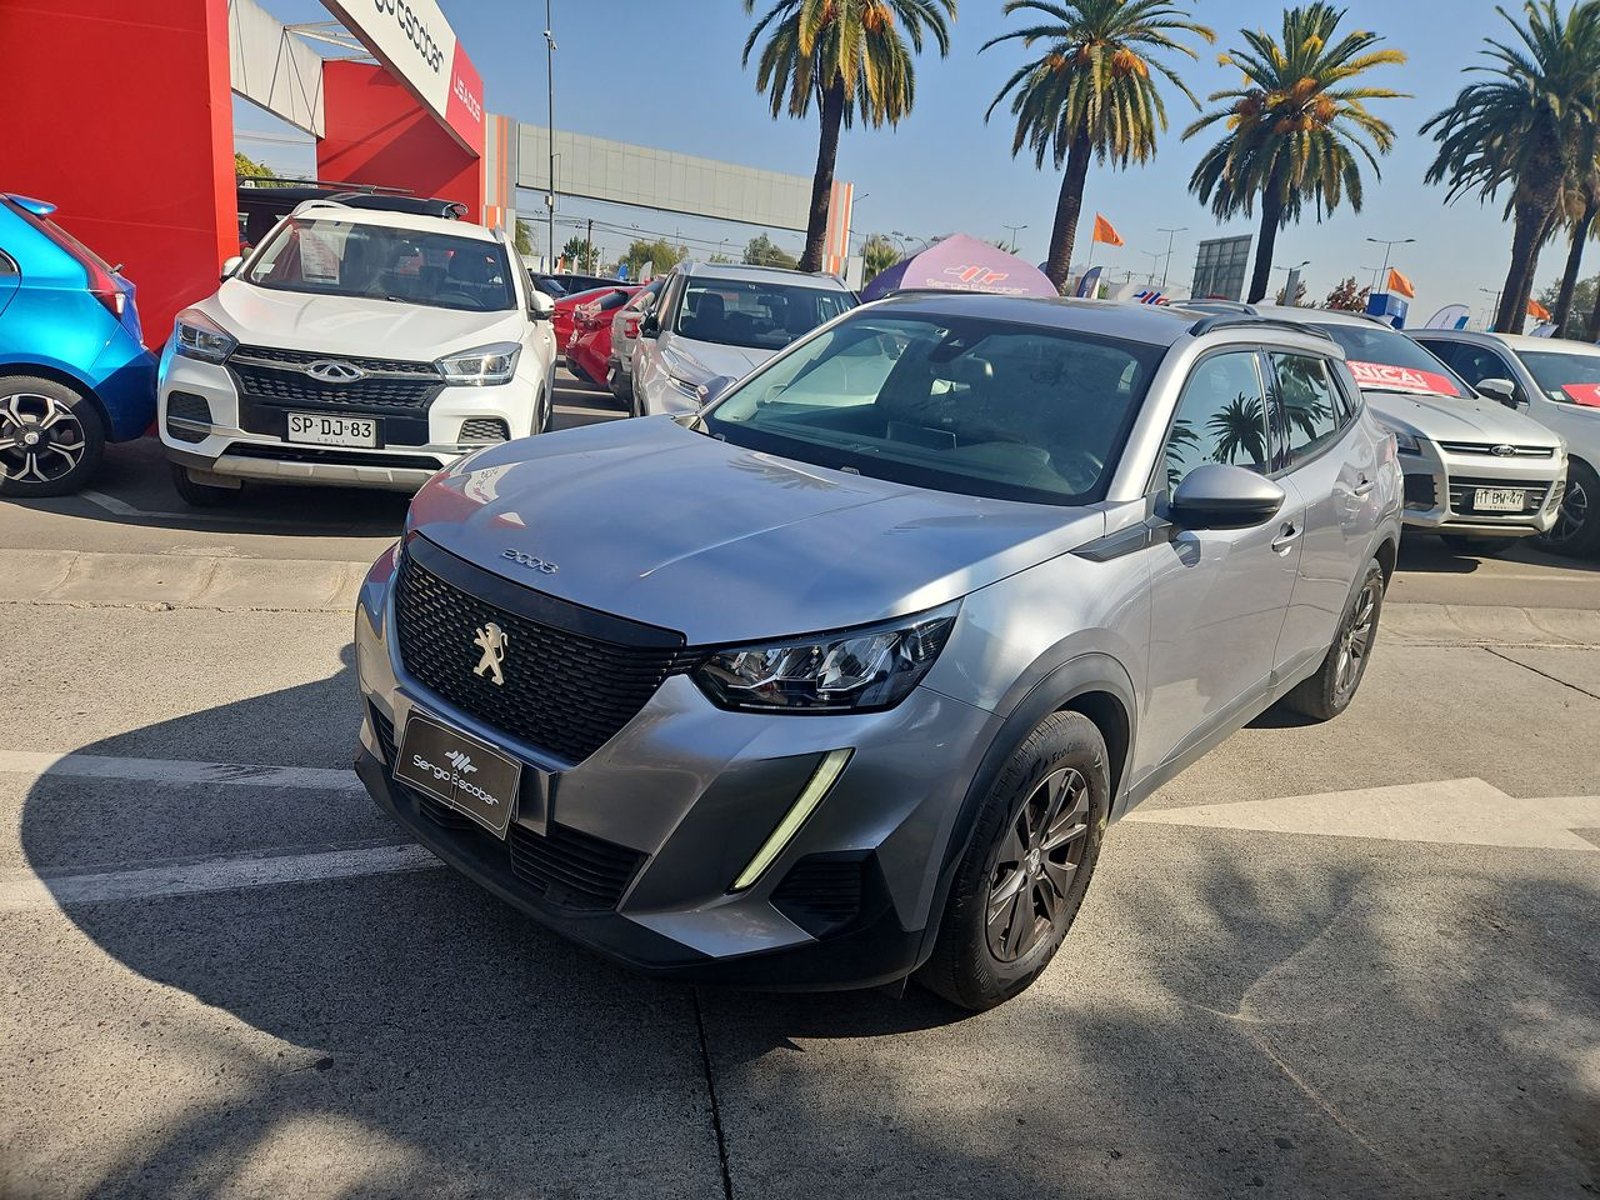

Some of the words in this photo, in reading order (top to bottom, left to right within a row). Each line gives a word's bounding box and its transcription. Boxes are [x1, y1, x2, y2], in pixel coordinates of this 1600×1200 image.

[453, 72, 480, 123] USADOS
[1350, 362, 1429, 388] NICA!
[502, 548, 559, 574] 2008
[412, 754, 451, 781] Sergo
[451, 772, 500, 806] Escobar
